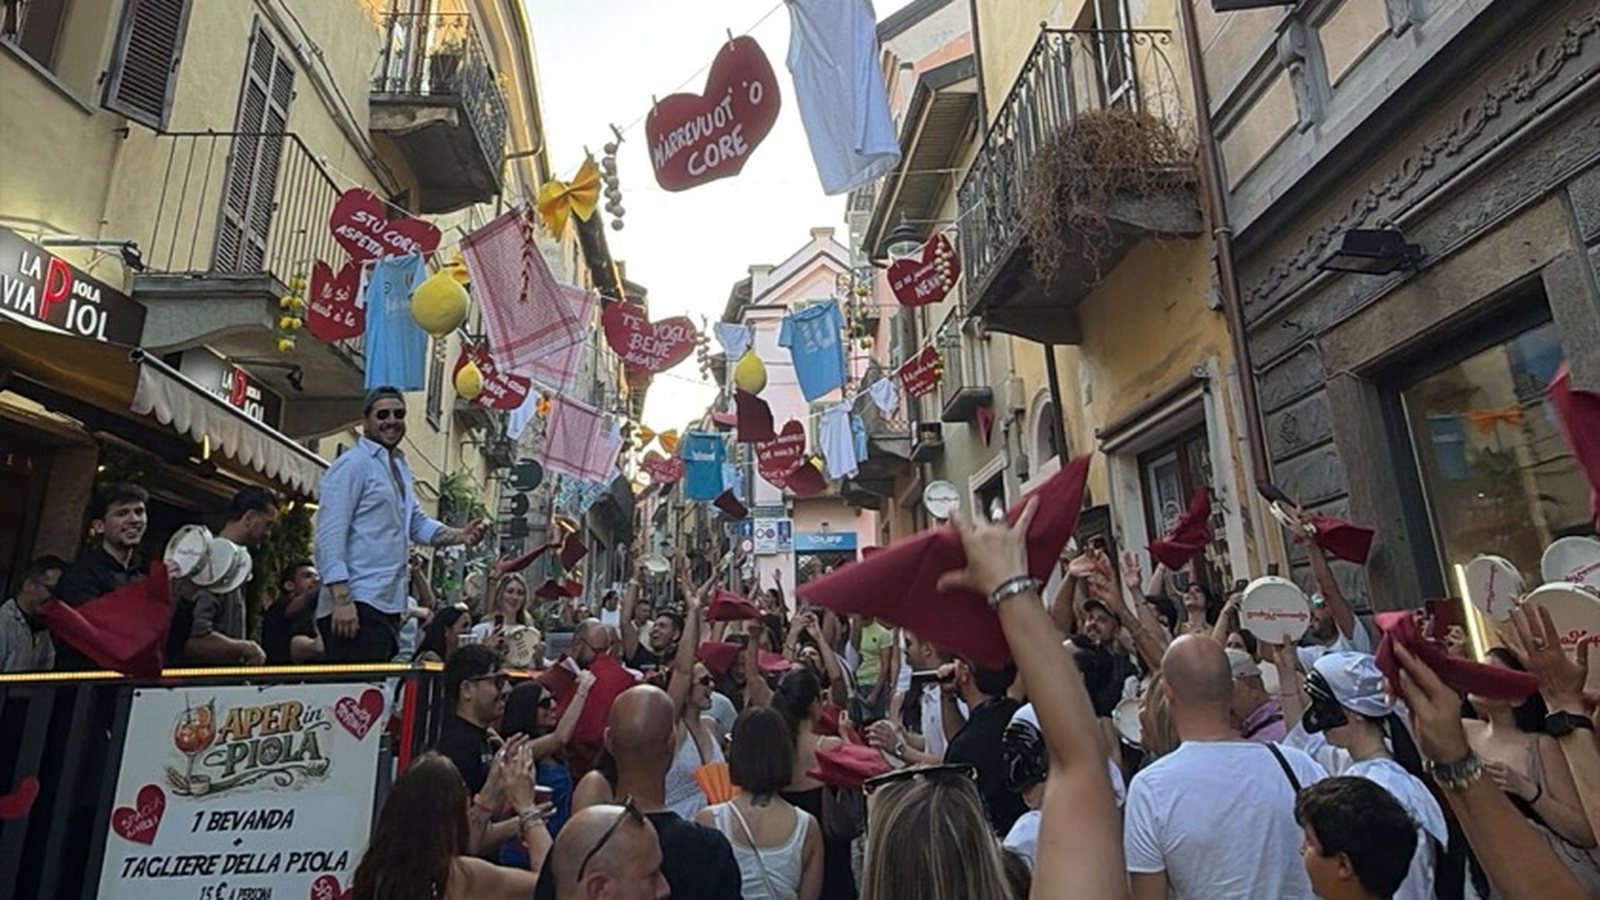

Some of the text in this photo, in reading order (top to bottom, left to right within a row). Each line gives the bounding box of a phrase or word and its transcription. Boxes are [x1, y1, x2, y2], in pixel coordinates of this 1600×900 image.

[687, 123, 748, 176] CORE
[335, 224, 385, 257] ASPETTA
[383, 230, 422, 257] CORE
[20, 251, 42, 280] LA
[1, 275, 36, 316] VIA
[621, 312, 643, 331] TE
[628, 332, 674, 358] BENE
[221, 370, 233, 389] LA
[215, 699, 304, 745] APER
[302, 705, 322, 725] in
[221, 730, 322, 778] PIOLA
[191, 809, 295, 833] 1 BEVANDA
[121, 850, 349, 878] TAGLIERE DELLA PIOLA
